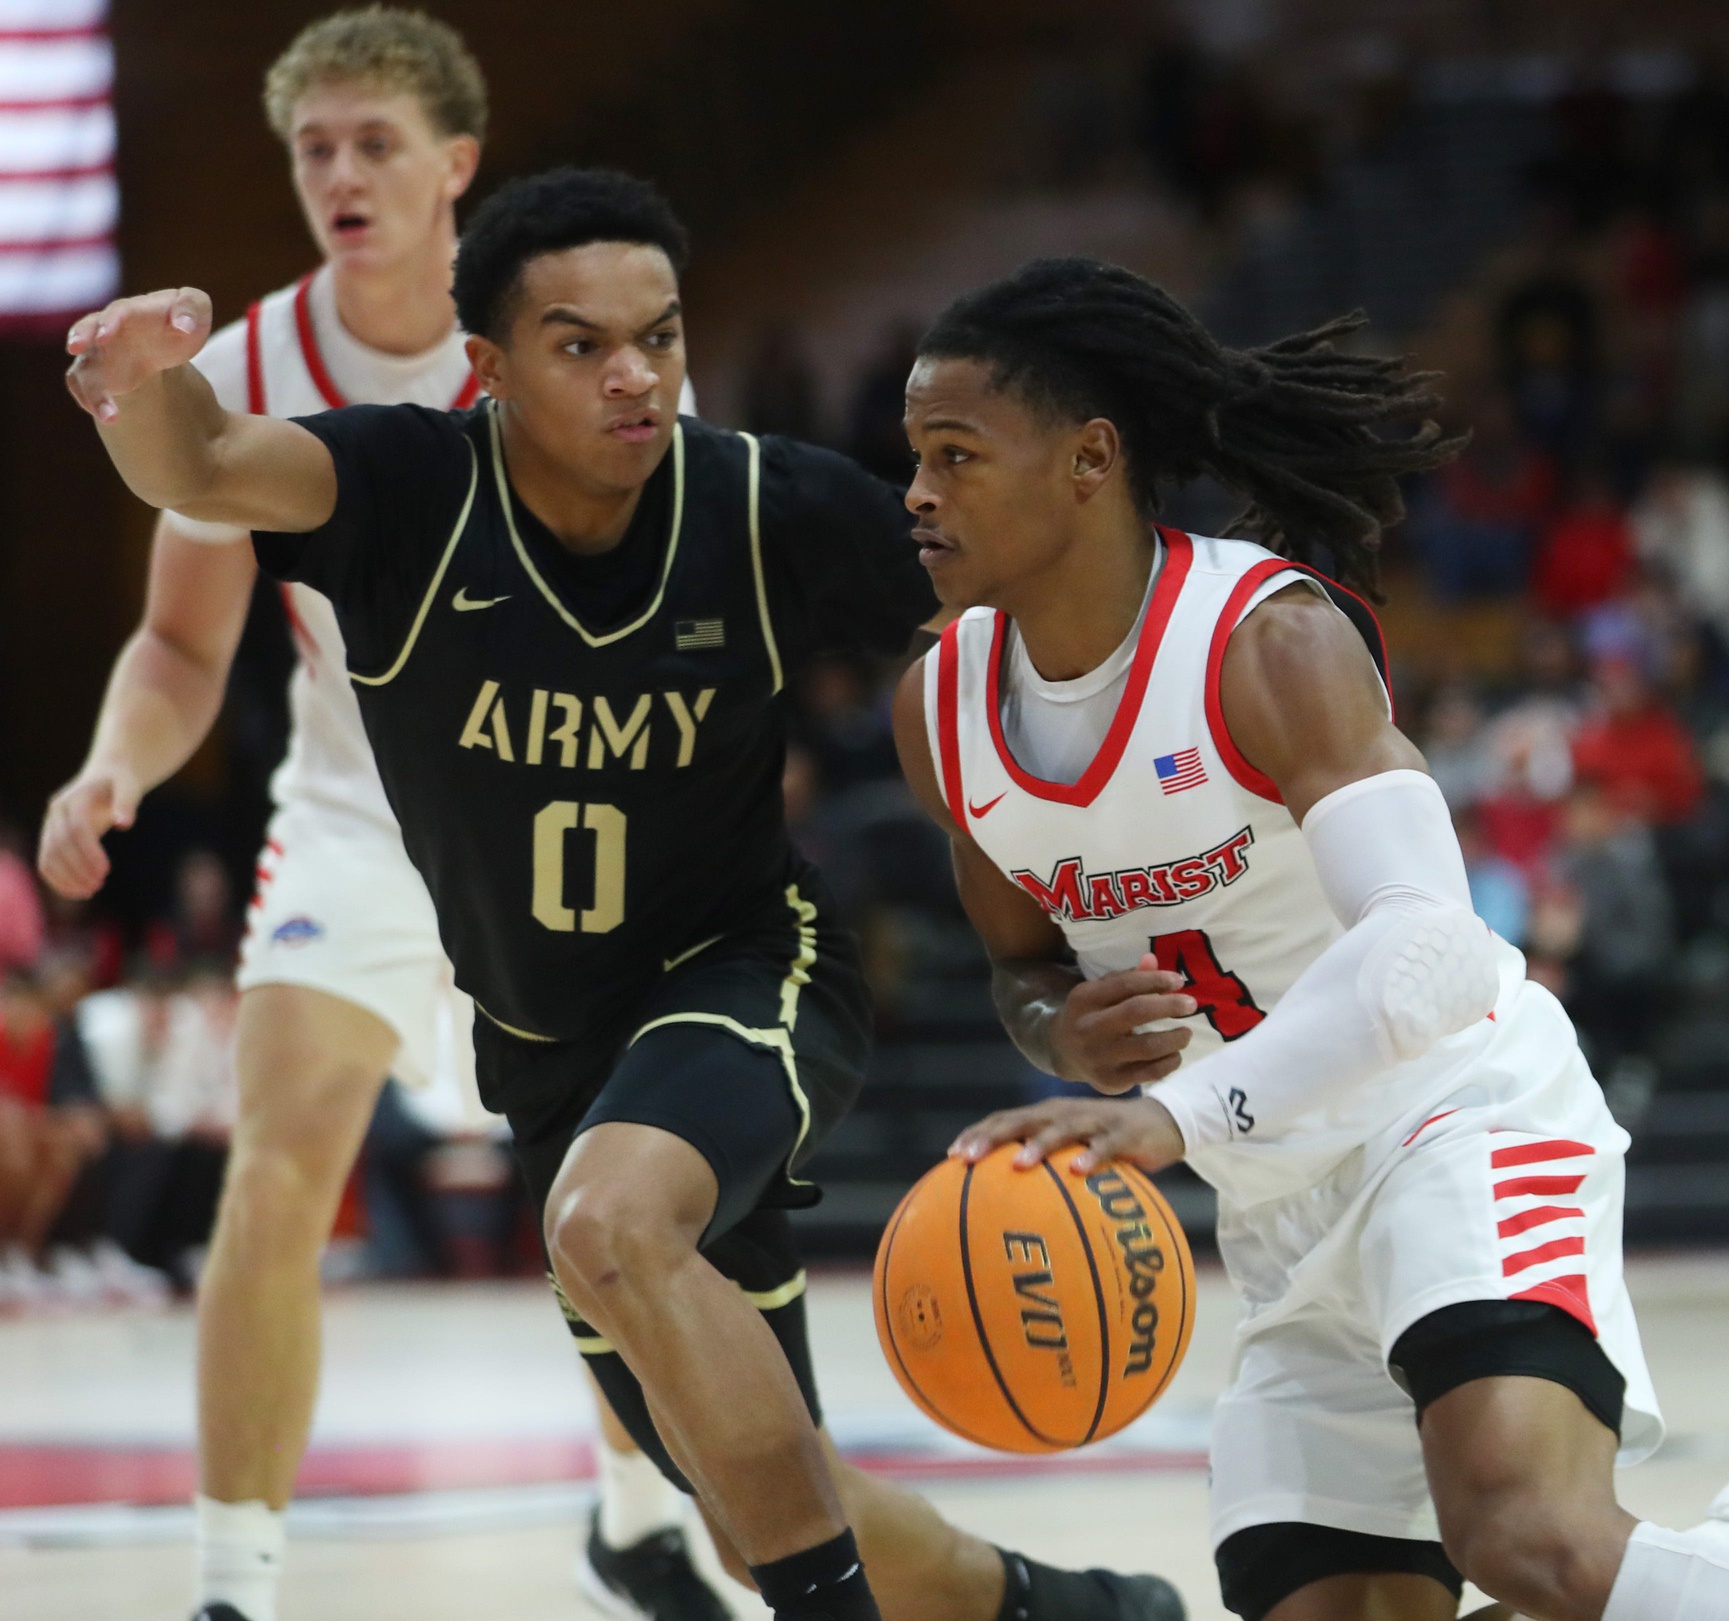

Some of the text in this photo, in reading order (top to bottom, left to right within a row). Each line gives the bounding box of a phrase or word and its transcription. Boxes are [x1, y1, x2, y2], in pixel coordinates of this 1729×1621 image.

[458, 680, 717, 770] ARMY
[532, 800, 627, 934] 0
[1010, 824, 1255, 923] MARIST
[1148, 928, 1268, 1043] 4
[1003, 1230, 1069, 1350] EVO
[1085, 1166, 1165, 1381] Wilson
